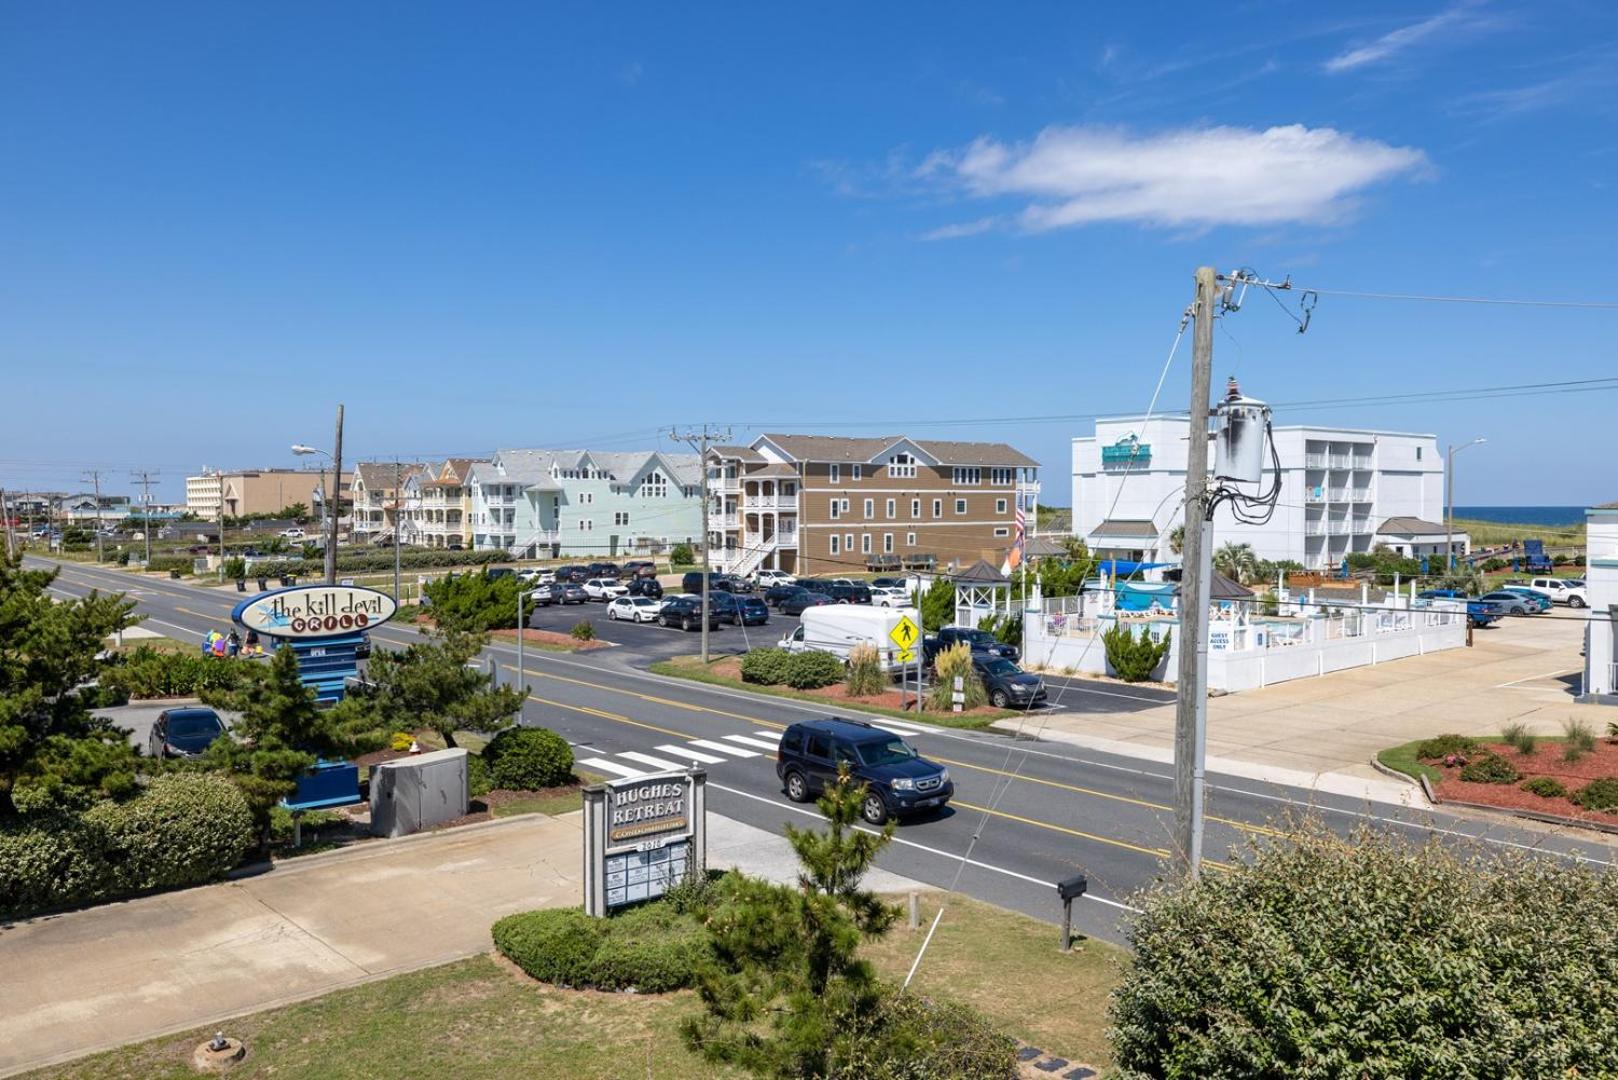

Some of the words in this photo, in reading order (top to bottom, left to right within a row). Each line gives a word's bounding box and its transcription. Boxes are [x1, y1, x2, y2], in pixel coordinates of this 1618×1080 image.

[272, 596, 301, 620] the
[305, 593, 336, 616] kill
[341, 592, 382, 614] devil
[292, 614, 368, 632] GRILL
[616, 783, 683, 807] HUGHES
[613, 799, 684, 825] RETREAT
